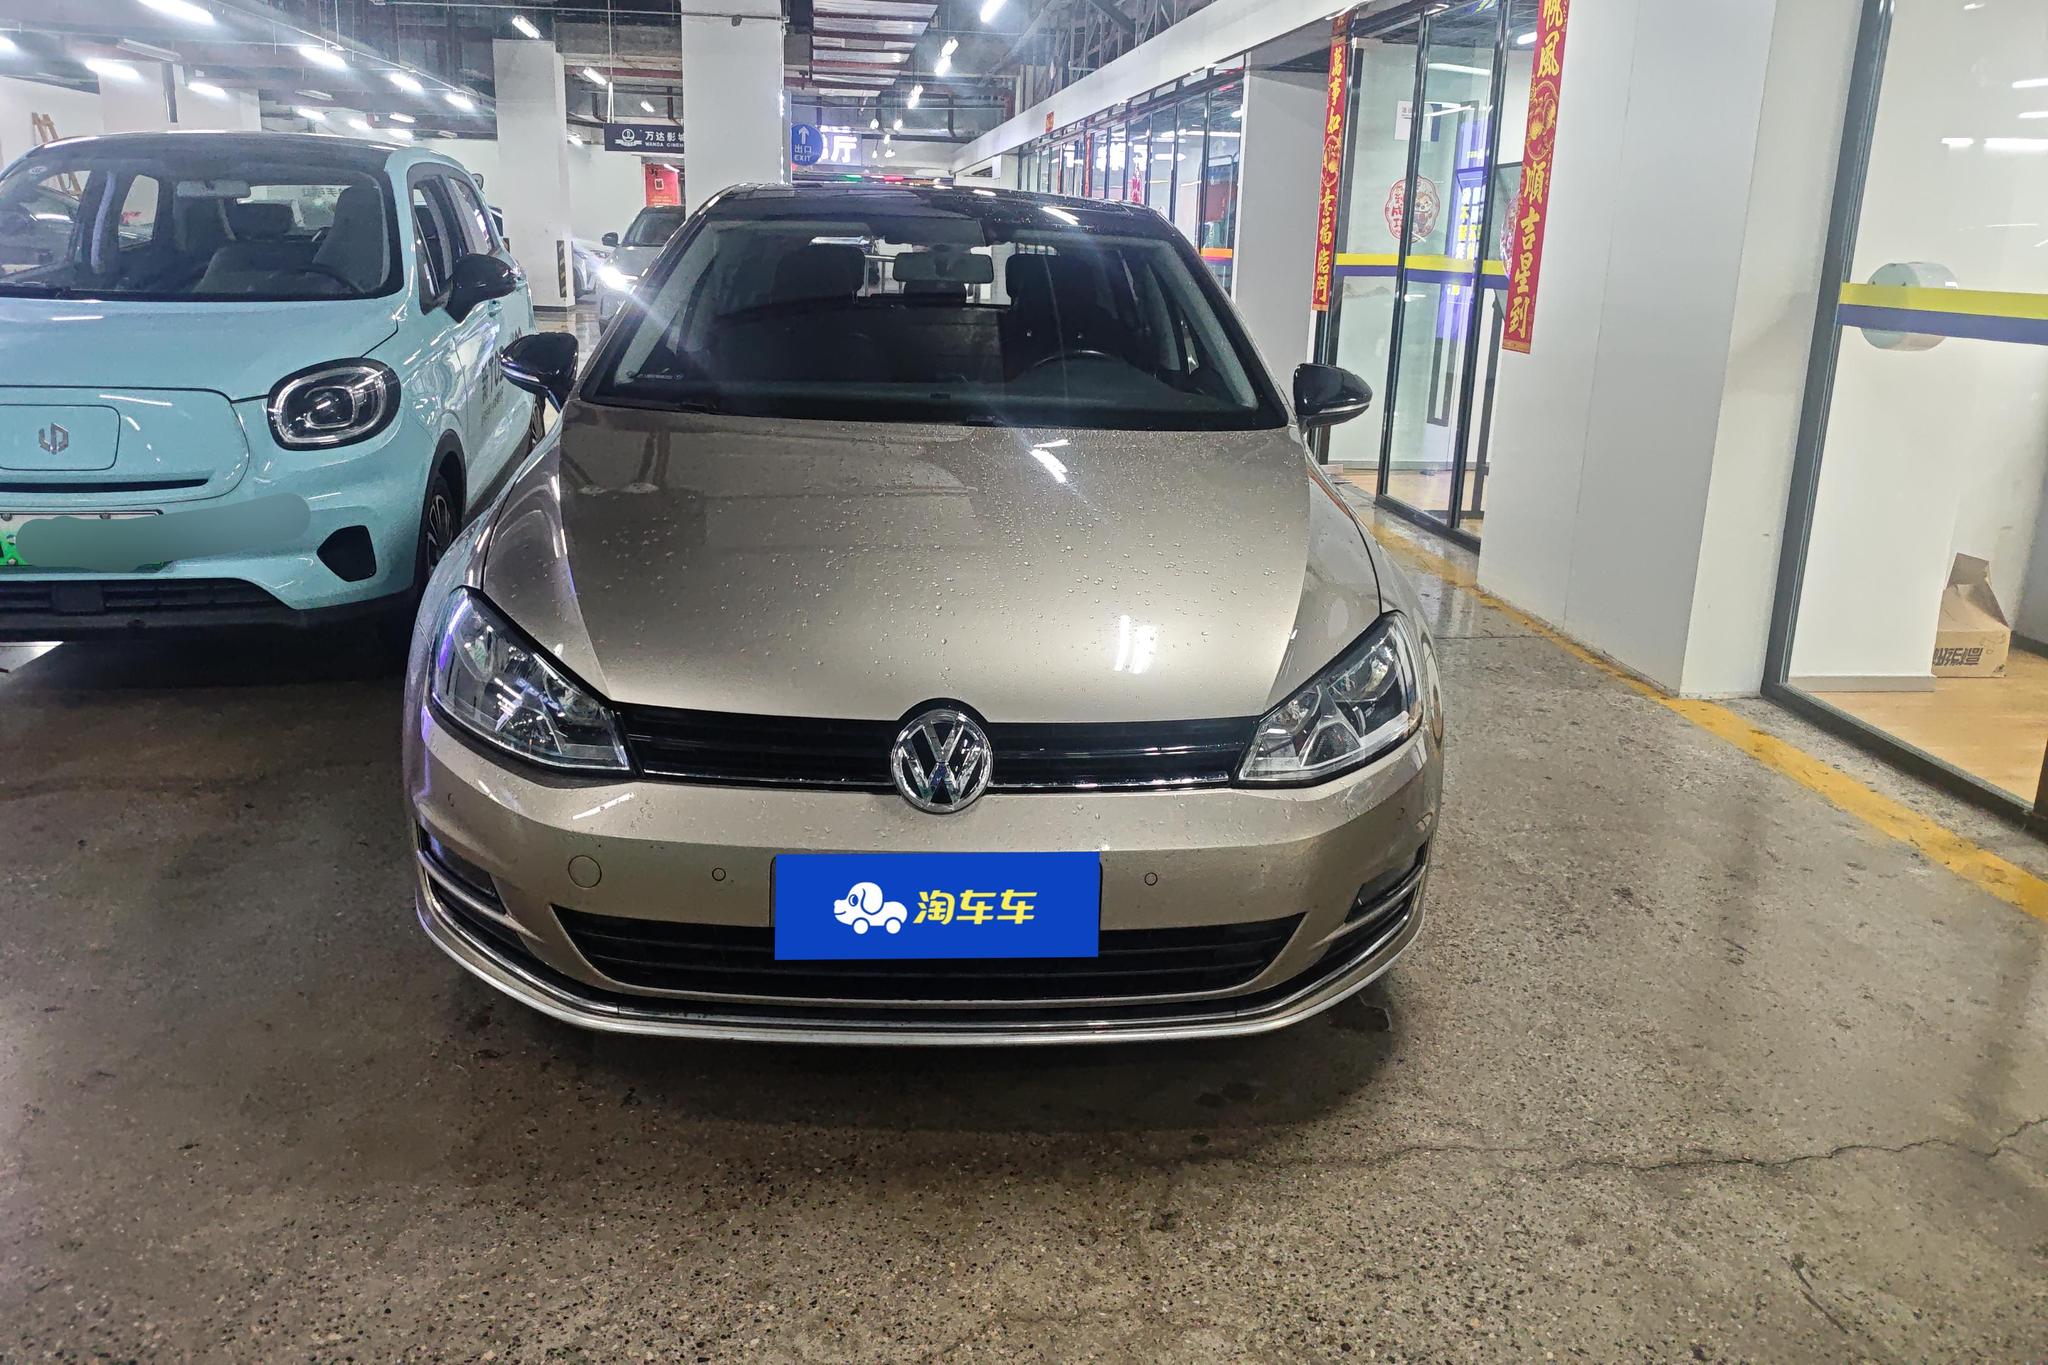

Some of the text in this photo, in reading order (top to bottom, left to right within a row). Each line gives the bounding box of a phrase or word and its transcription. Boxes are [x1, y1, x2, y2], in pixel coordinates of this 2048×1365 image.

[794, 144, 812, 154] 出口
[820, 133, 858, 163] 厅
[794, 154, 811, 162] EXIT
[1932, 647, 1983, 667] 高档纸
